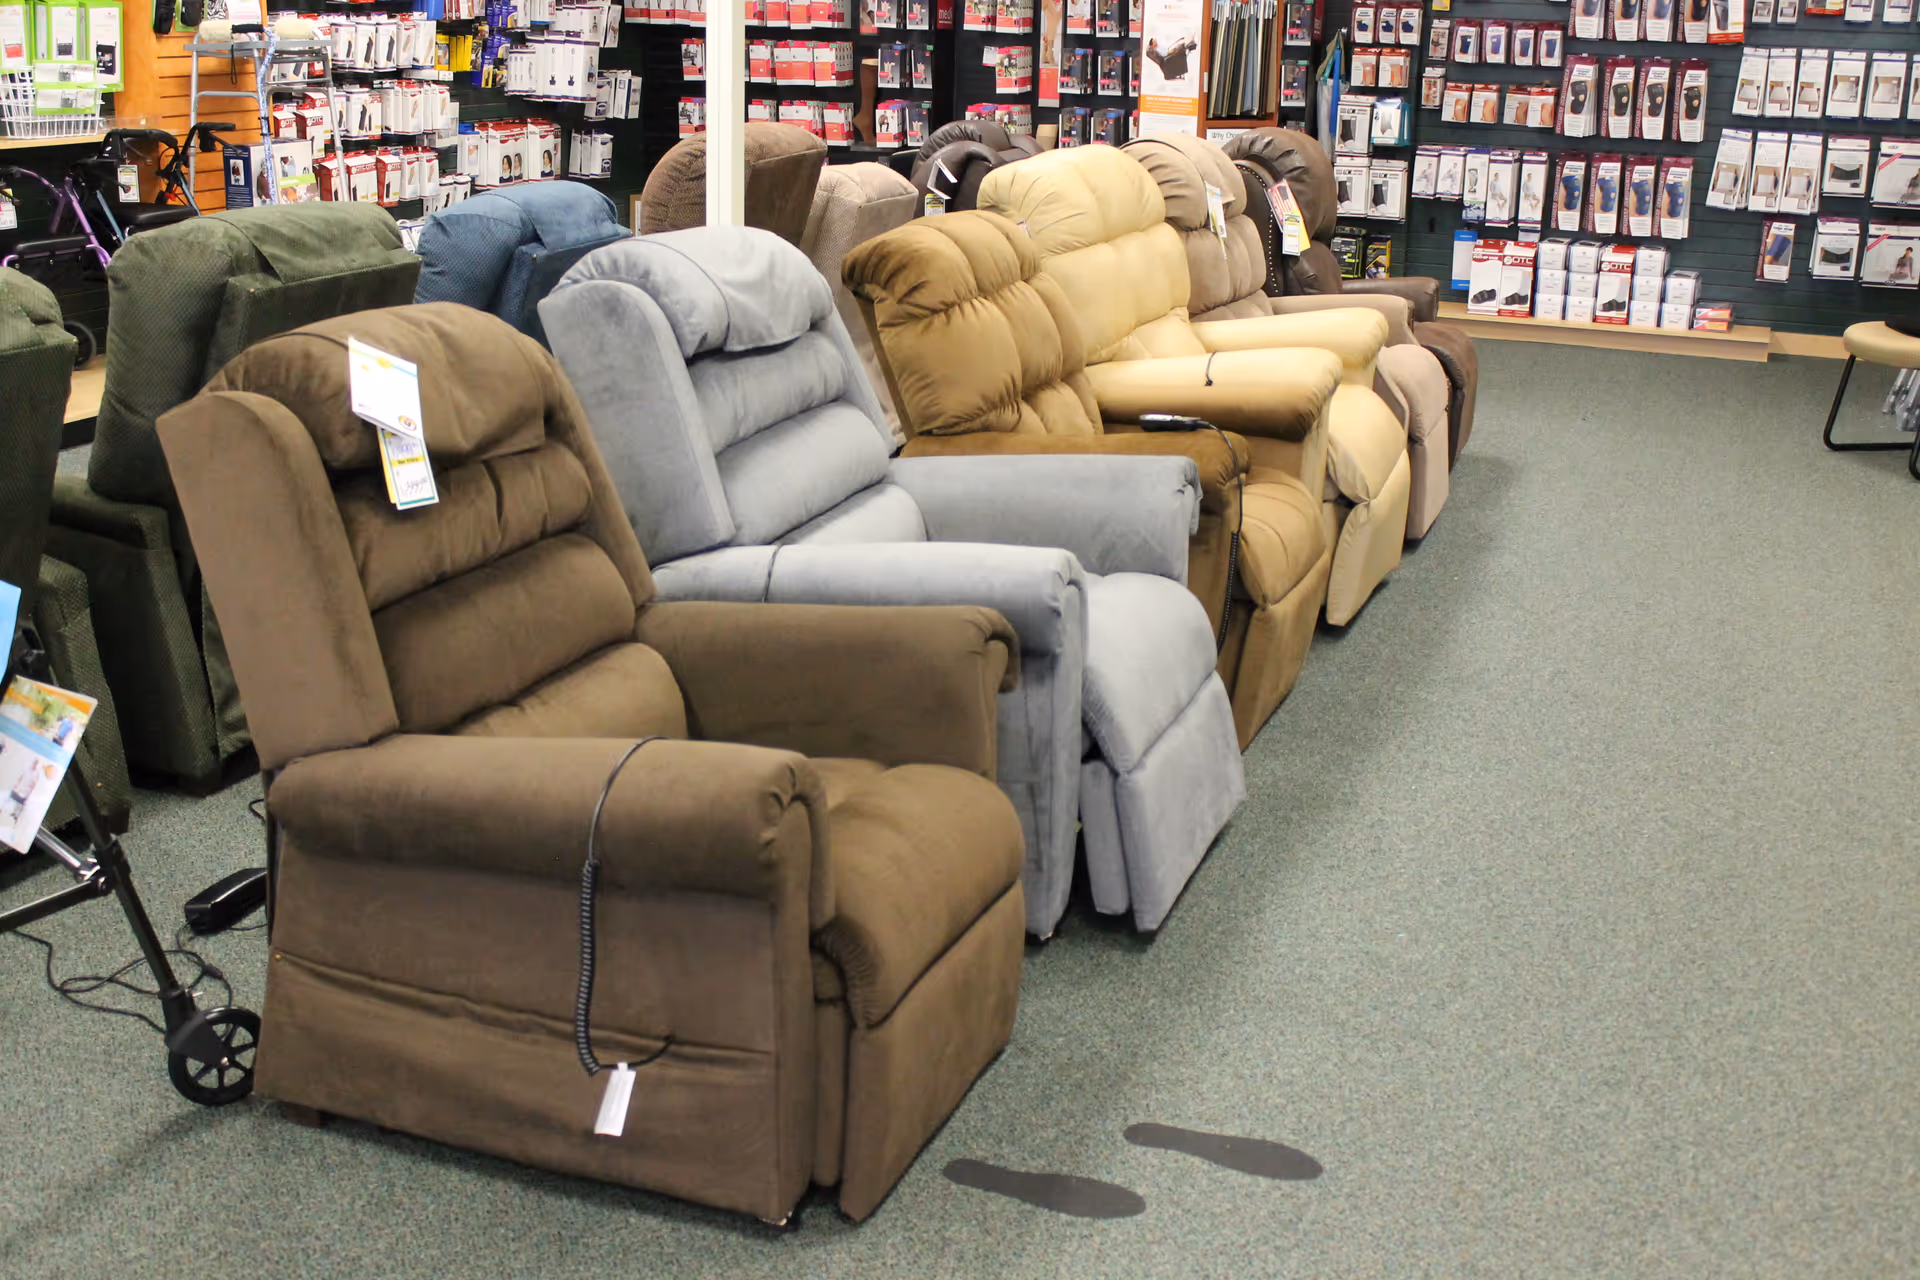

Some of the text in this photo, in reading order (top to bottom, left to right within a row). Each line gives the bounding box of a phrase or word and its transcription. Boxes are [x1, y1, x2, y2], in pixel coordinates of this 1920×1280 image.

[1211, 132, 1224, 140] Why
[1512, 256, 1533, 265] OTC
[1609, 262, 1631, 270] OTC
